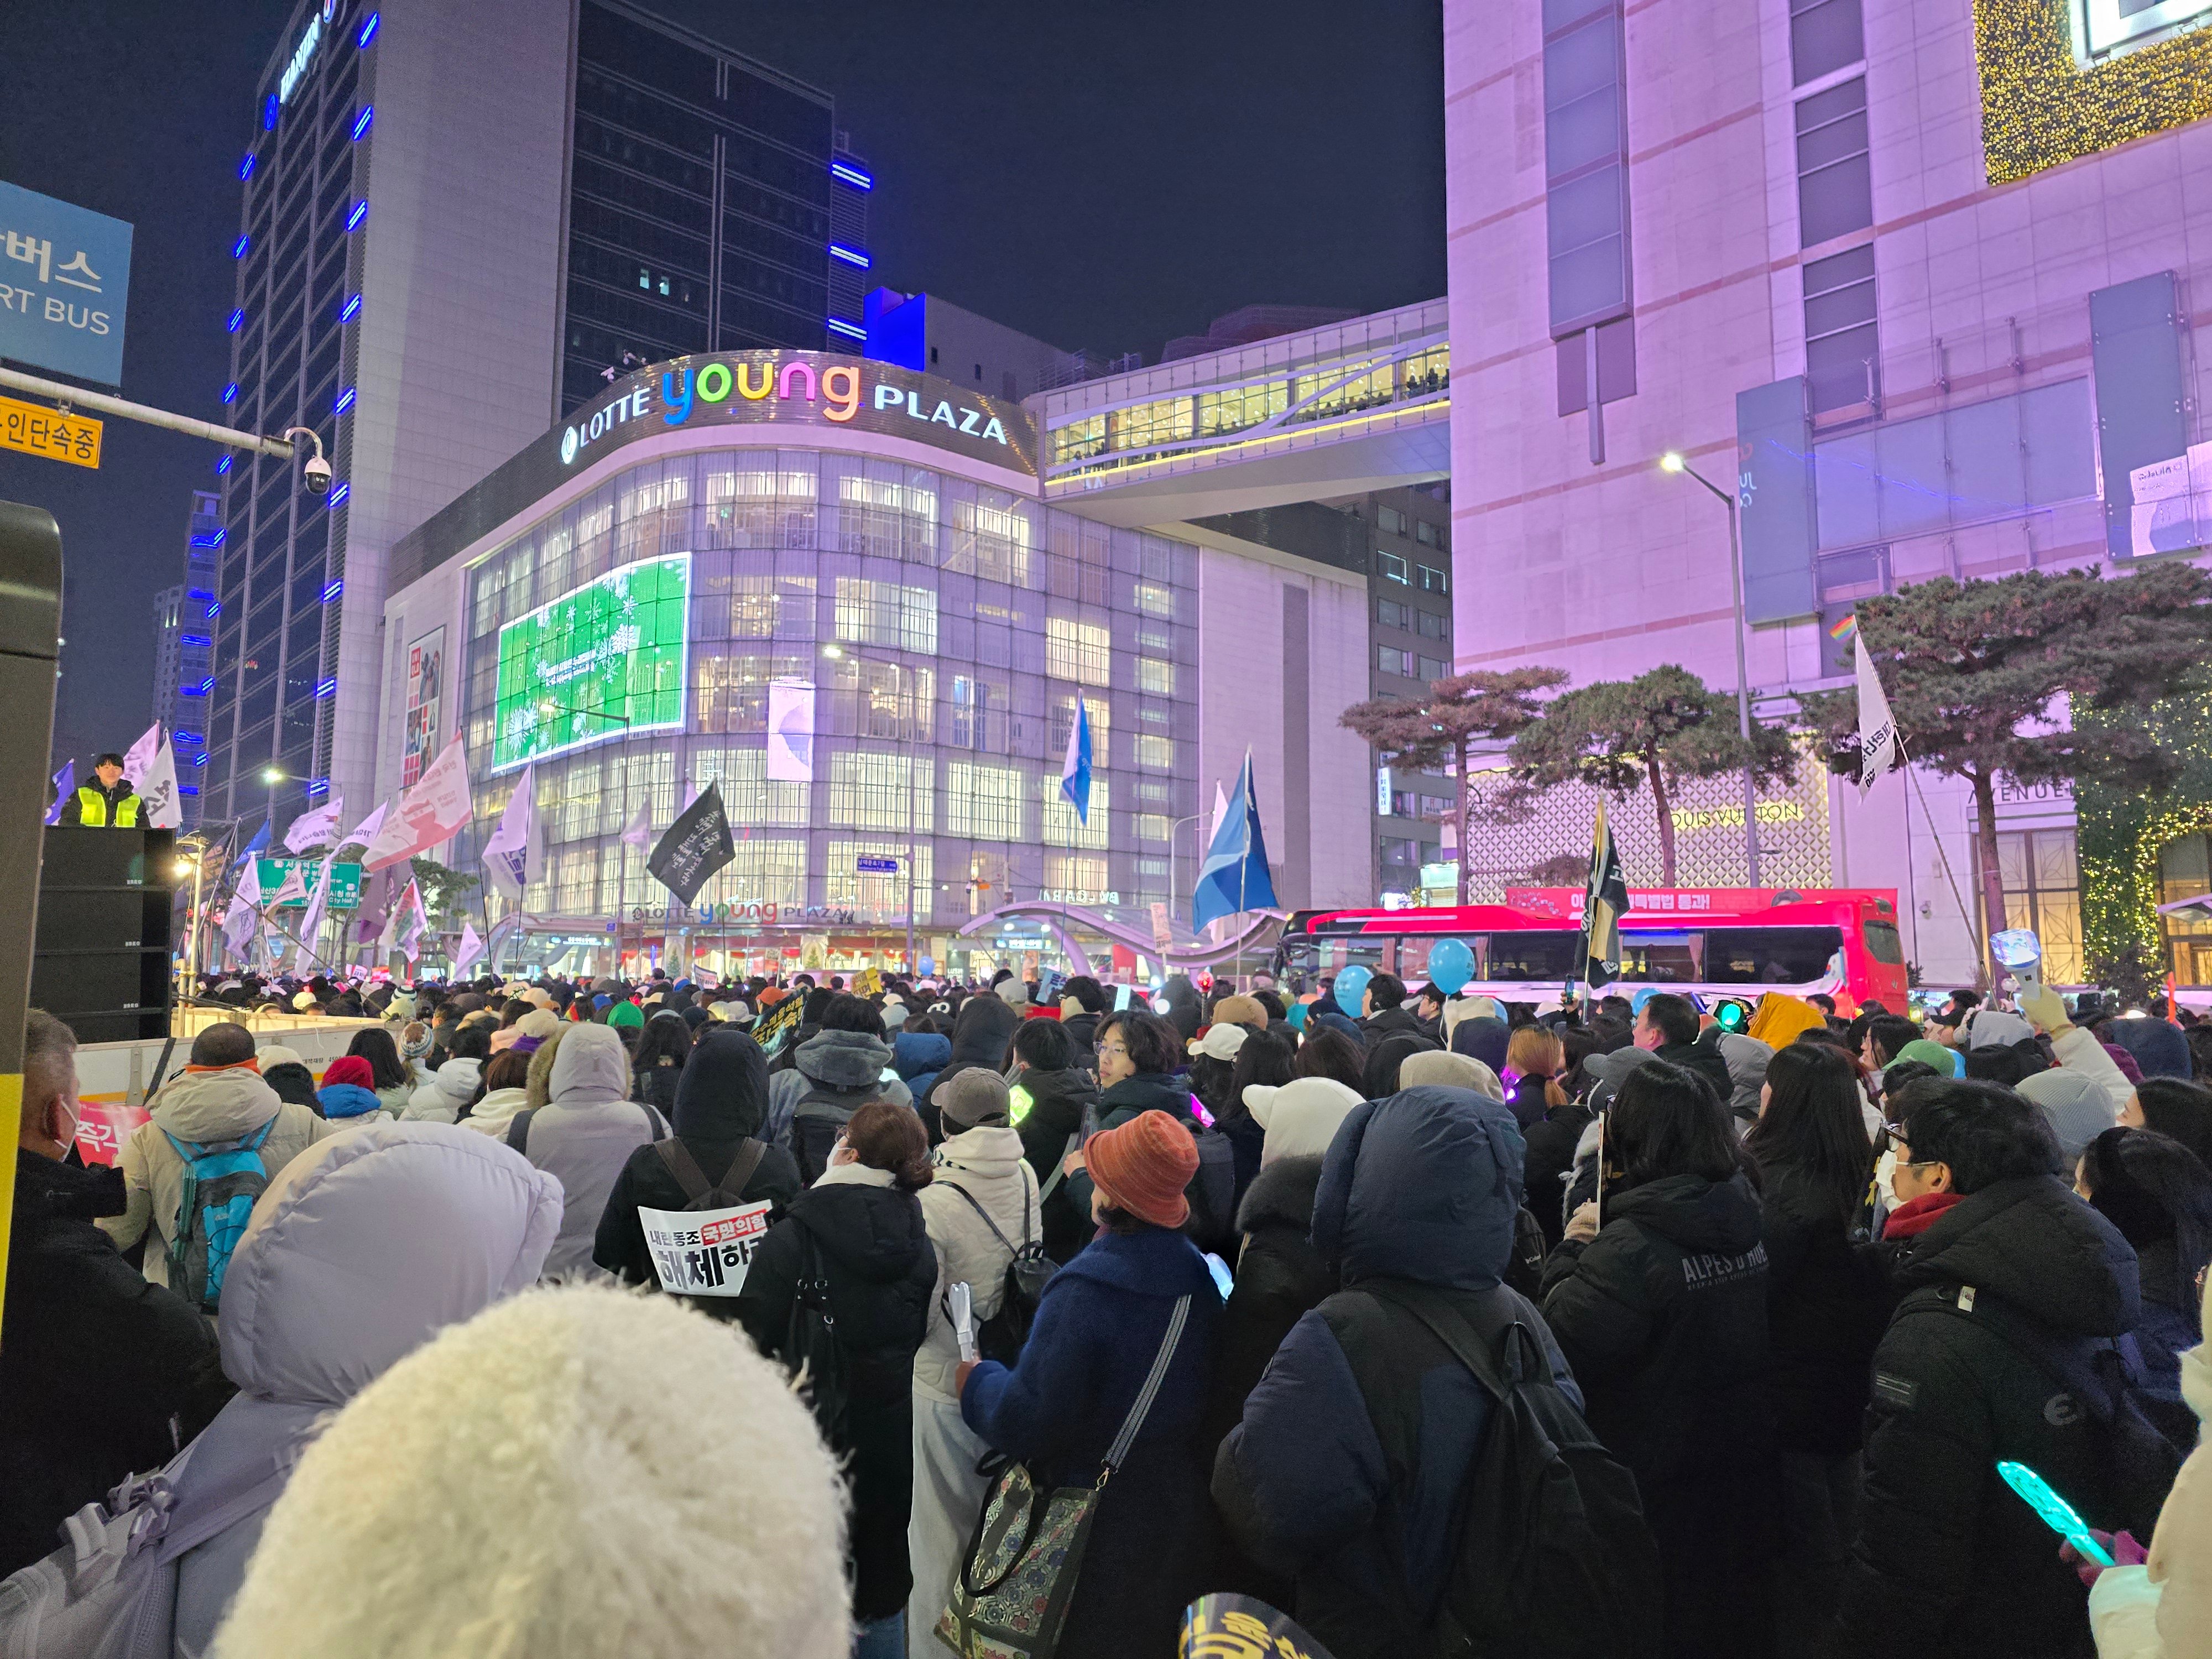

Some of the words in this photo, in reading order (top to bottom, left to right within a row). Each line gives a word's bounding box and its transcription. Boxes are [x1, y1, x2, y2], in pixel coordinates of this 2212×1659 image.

[0, 231, 102, 293] 버스
[0, 284, 35, 315] RT
[44, 299, 110, 335] BUS
[580, 386, 651, 447] LOTTE
[663, 362, 860, 424] young
[875, 384, 1008, 445] PLAZA
[0, 411, 95, 460] 인단속중
[1671, 811, 1711, 827] OUIS
[700, 902, 778, 925] young
[785, 907, 844, 918] PLAZA
[649, 1230, 701, 1247] 내란동조
[655, 1239, 759, 1290] 해체하
[1682, 1254, 1733, 1283] ALPES
